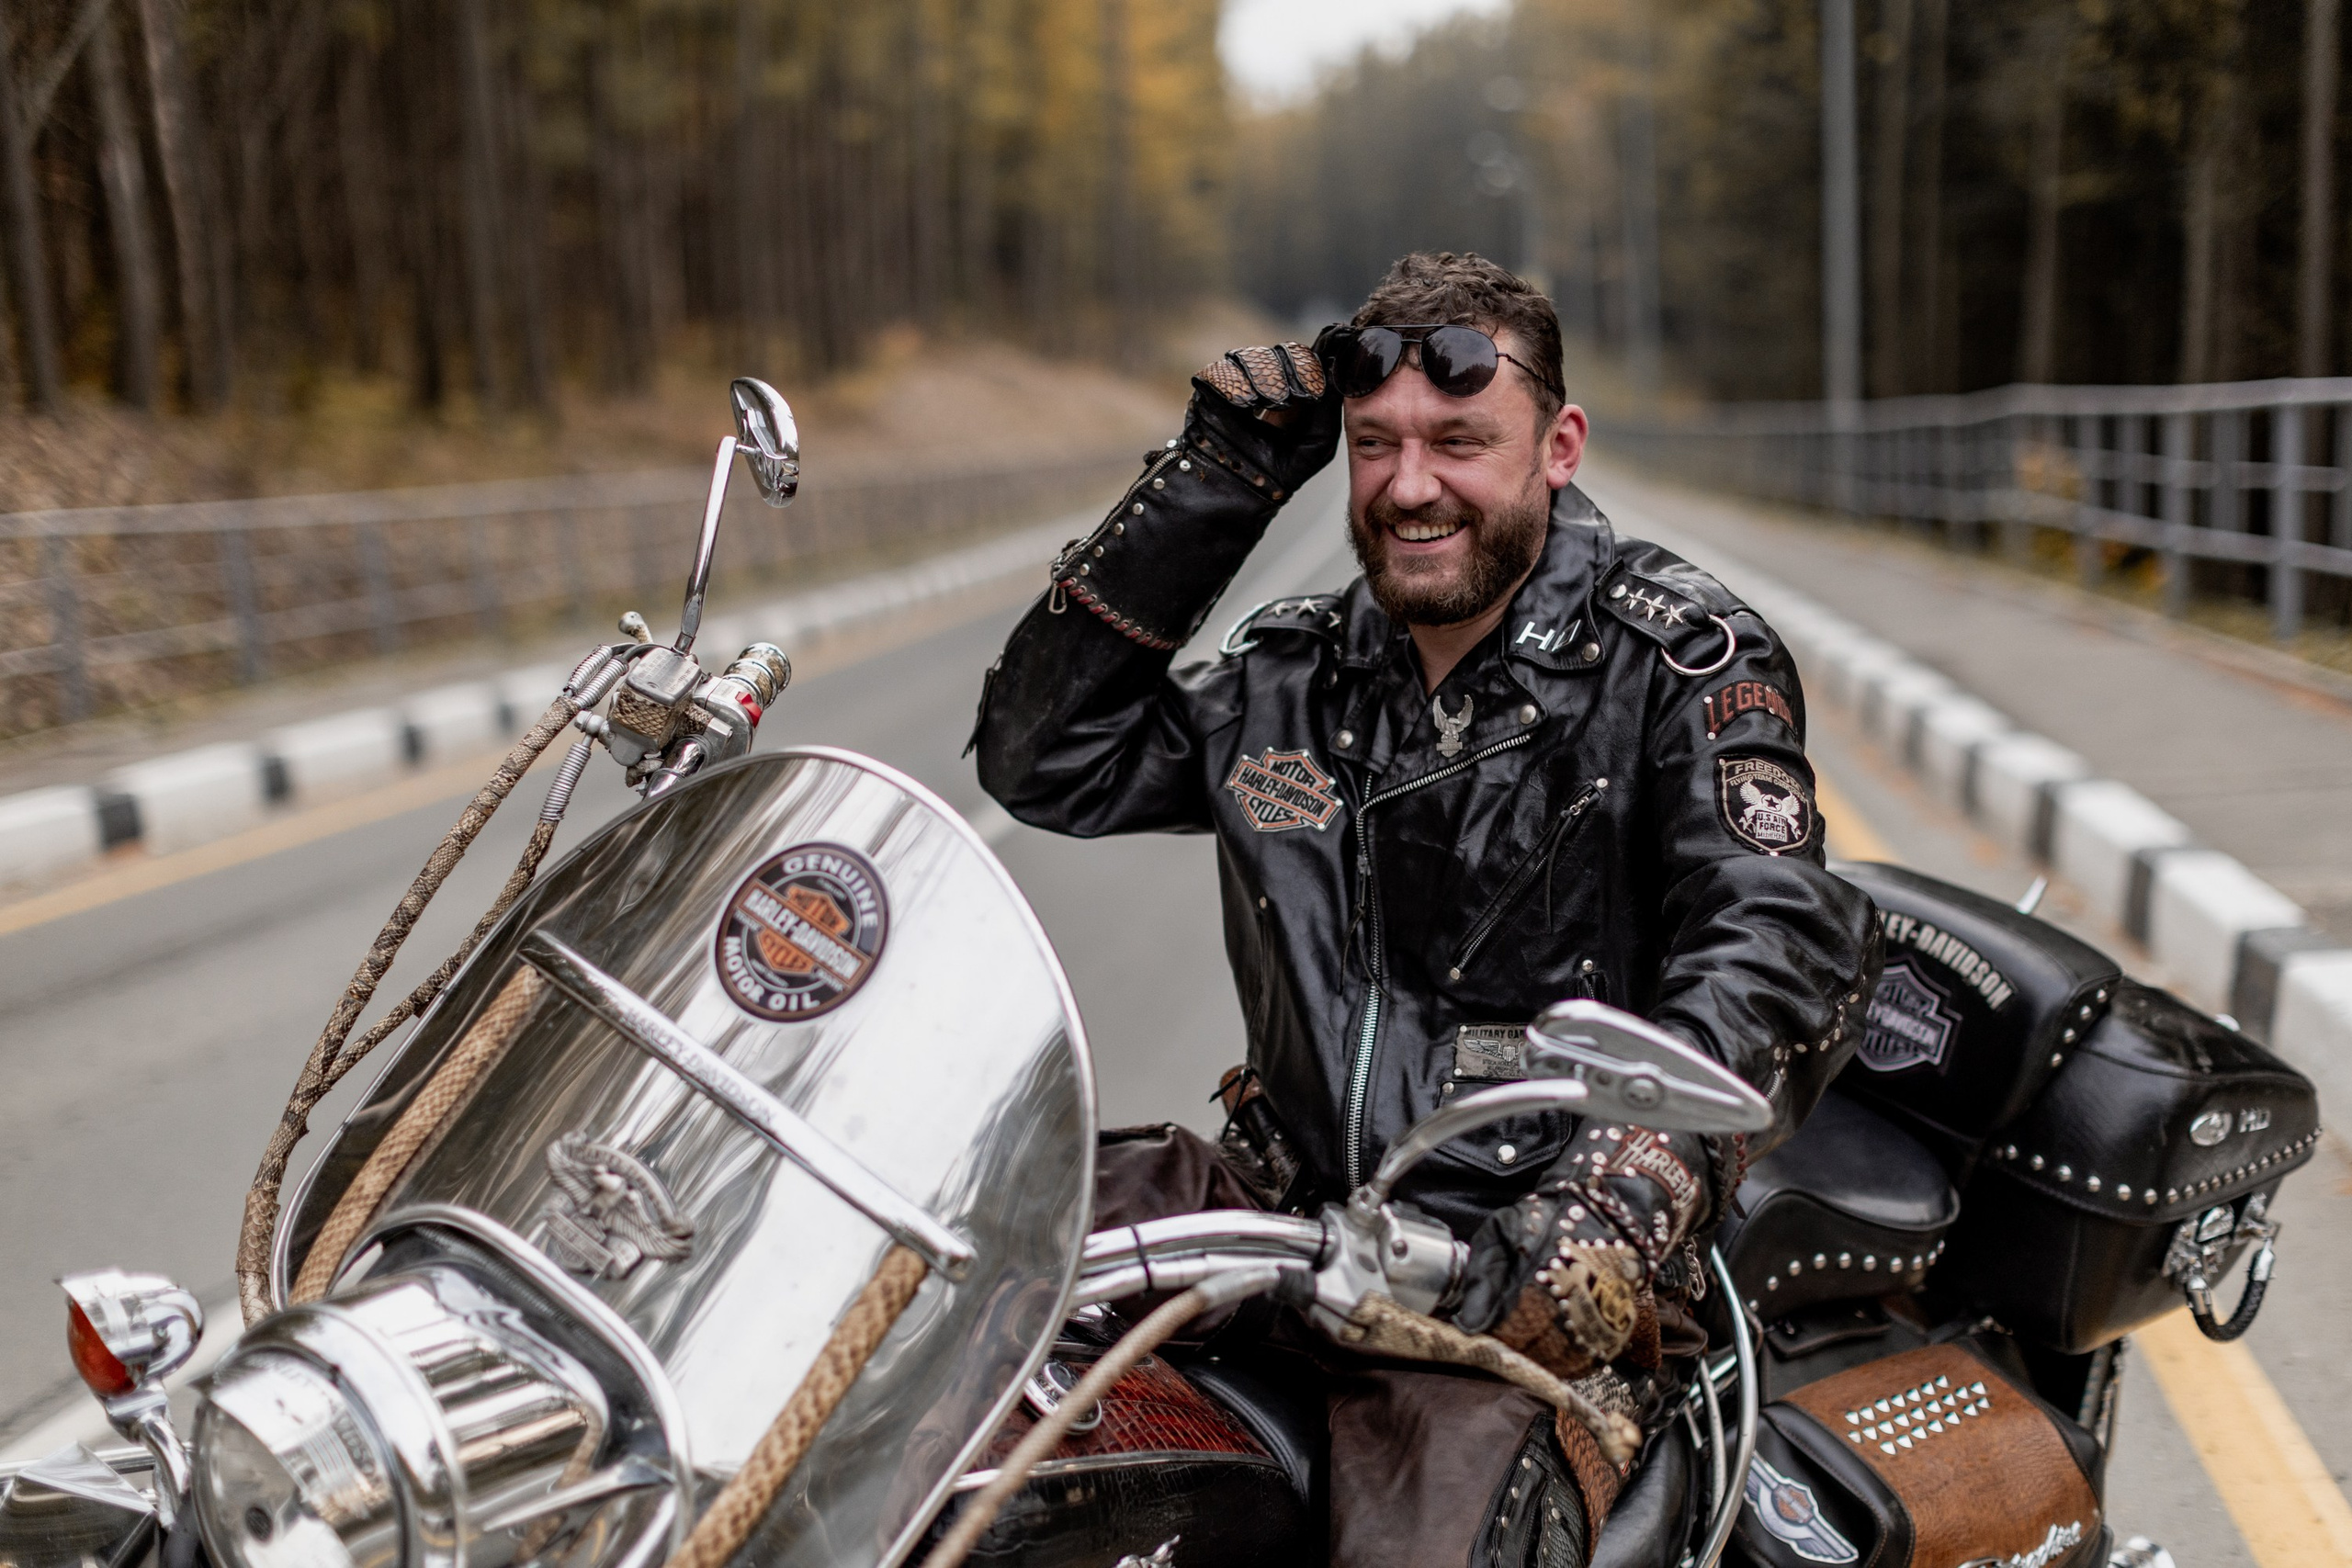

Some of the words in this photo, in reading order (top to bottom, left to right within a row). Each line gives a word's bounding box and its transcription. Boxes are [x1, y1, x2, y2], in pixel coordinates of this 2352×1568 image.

[1238, 767, 1329, 818] HARLEY-DAVIDSON
[1270, 760, 1317, 788] MOTOR
[1249, 796, 1294, 823] CYCLES
[1759, 822, 1786, 834] FORCE
[1773, 816, 1787, 825] AIR
[783, 854, 878, 928] GENUINE
[742, 888, 862, 979] HARLEY-DAVIDSON
[725, 936, 764, 1003] MOTOR
[768, 992, 820, 1011] OIL
[1881, 910, 2013, 1010] EY-DAVIDSON
[1464, 1029, 1506, 1039] MILITARY
